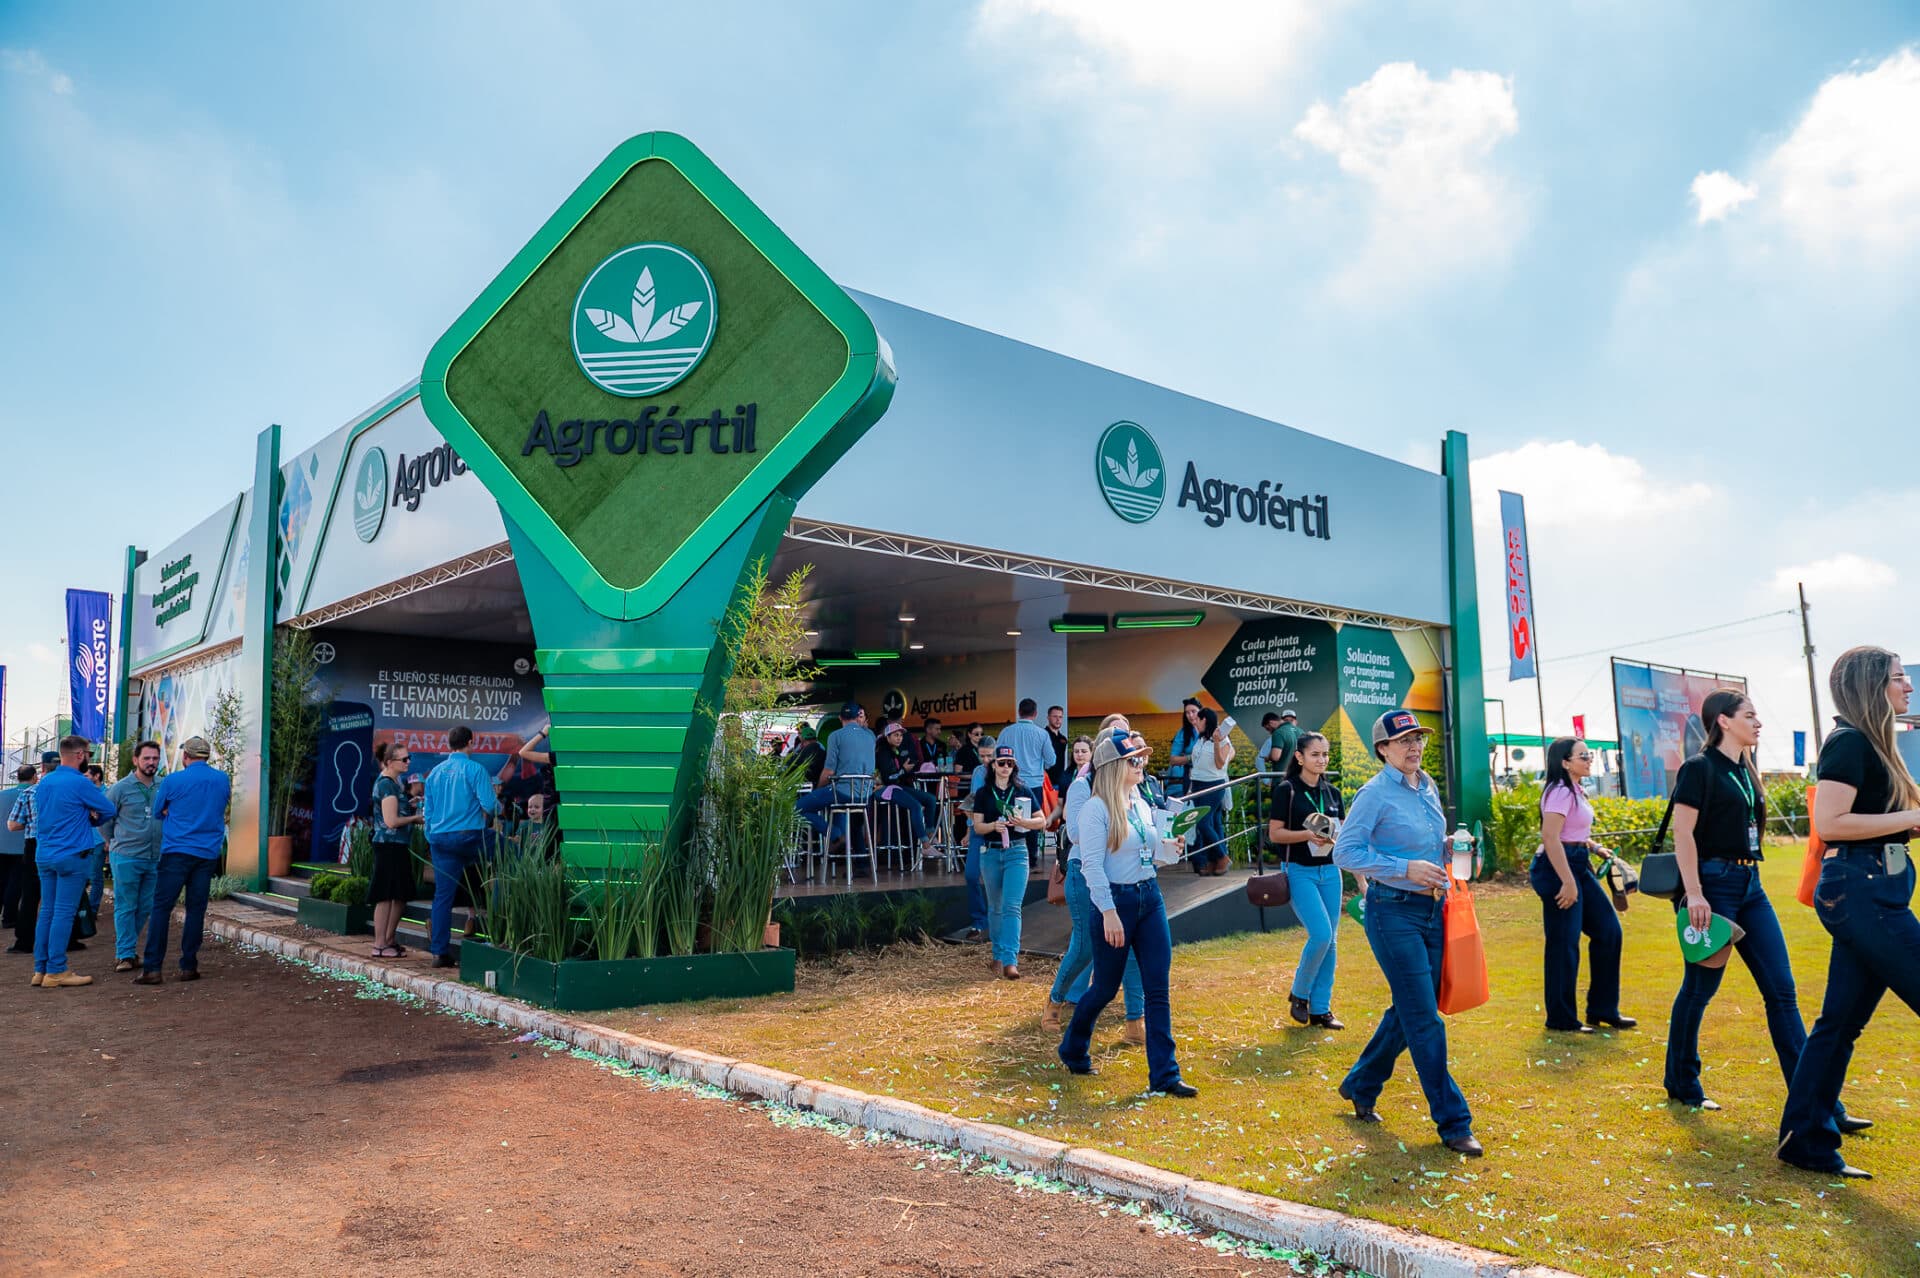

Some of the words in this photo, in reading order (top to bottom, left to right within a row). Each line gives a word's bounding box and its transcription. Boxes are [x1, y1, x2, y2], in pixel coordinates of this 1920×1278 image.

[521, 402, 758, 468] Agrofértil
[1176, 460, 1331, 540] Agrofértil
[1241, 637, 1266, 651] Cada
[1267, 635, 1299, 651] planta
[1235, 655, 1245, 664] es
[1247, 651, 1256, 663] el
[1257, 645, 1302, 662] resultado
[1303, 644, 1317, 656] de
[1346, 647, 1390, 666] Soluciones
[1229, 658, 1313, 678] conocimiento,
[1343, 665, 1356, 677] que
[378, 670, 391, 681] EL
[392, 670, 427, 684] SUEÑO
[428, 673, 440, 685] SE
[442, 673, 467, 686] HACE
[469, 675, 514, 689] REALIDAD
[1236, 675, 1277, 695] pasión
[1279, 677, 1288, 692] y
[1350, 676, 1357, 688] el
[1357, 680, 1380, 692] campo
[368, 683, 388, 700] TE
[391, 684, 468, 704] LLEVAMOS
[471, 689, 481, 704] A
[485, 689, 522, 706] VIVIR
[911, 690, 977, 719] Agrofértil
[1233, 688, 1299, 707] tecnología.
[1344, 690, 1397, 706] productividad
[382, 701, 400, 718] EL
[403, 702, 470, 720] MUNDIAL
[474, 705, 509, 721] 2026
